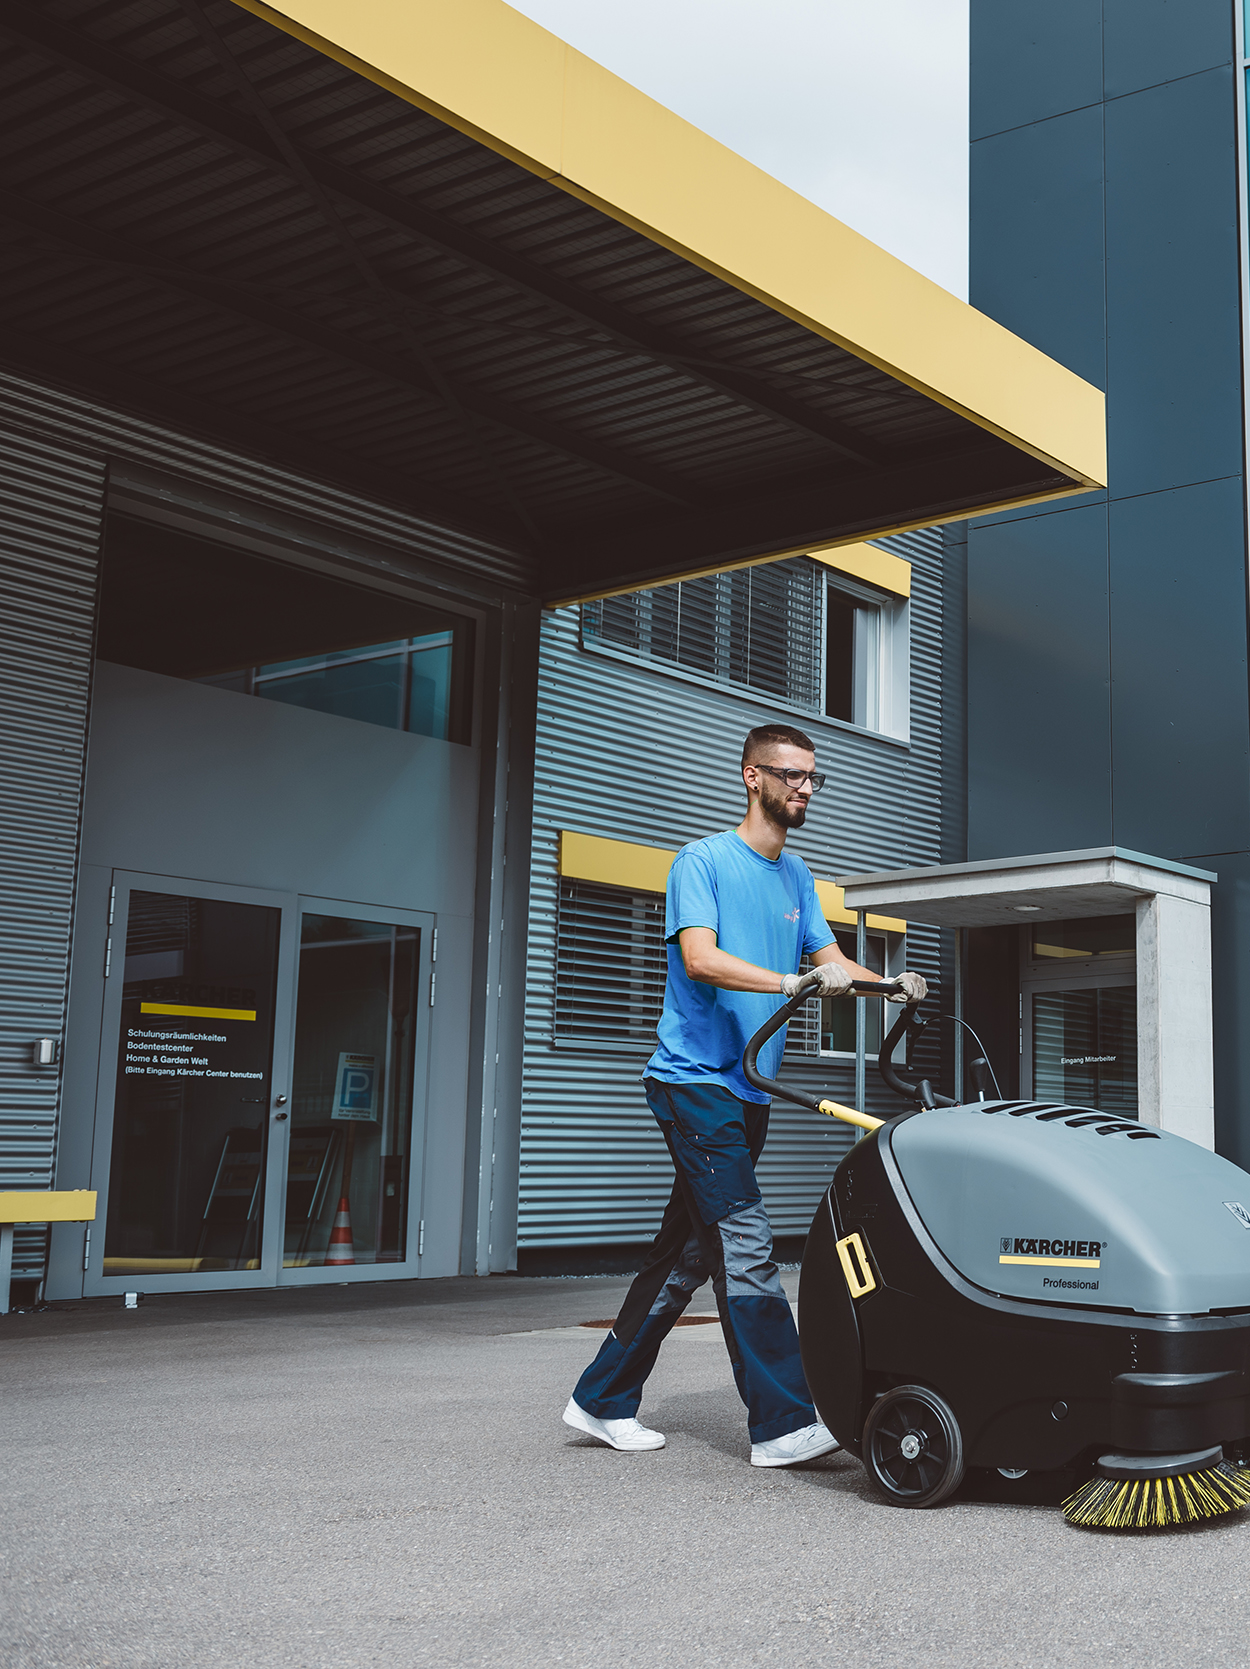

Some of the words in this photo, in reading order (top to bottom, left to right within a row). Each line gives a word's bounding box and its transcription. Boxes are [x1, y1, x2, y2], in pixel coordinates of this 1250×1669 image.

[128, 1028, 227, 1042] Schulungsräumlichkeiten
[127, 1041, 194, 1052] Bodentestcenter
[126, 1053, 151, 1062] Home
[152, 1055, 158, 1063] &
[160, 1055, 190, 1064] Garden
[191, 1057, 209, 1066] Welt
[1061, 1057, 1084, 1065] Eingang
[1084, 1055, 1116, 1063] Mitarbeiter
[125, 1066, 145, 1074] (Bitte
[146, 1067, 176, 1077] Eingang
[177, 1068, 205, 1077] Kärcher
[205, 1069, 229, 1078] Center
[230, 1071, 263, 1080] benutzen)
[344, 1071, 370, 1105] P
[1043, 1277, 1100, 1290] Professional
